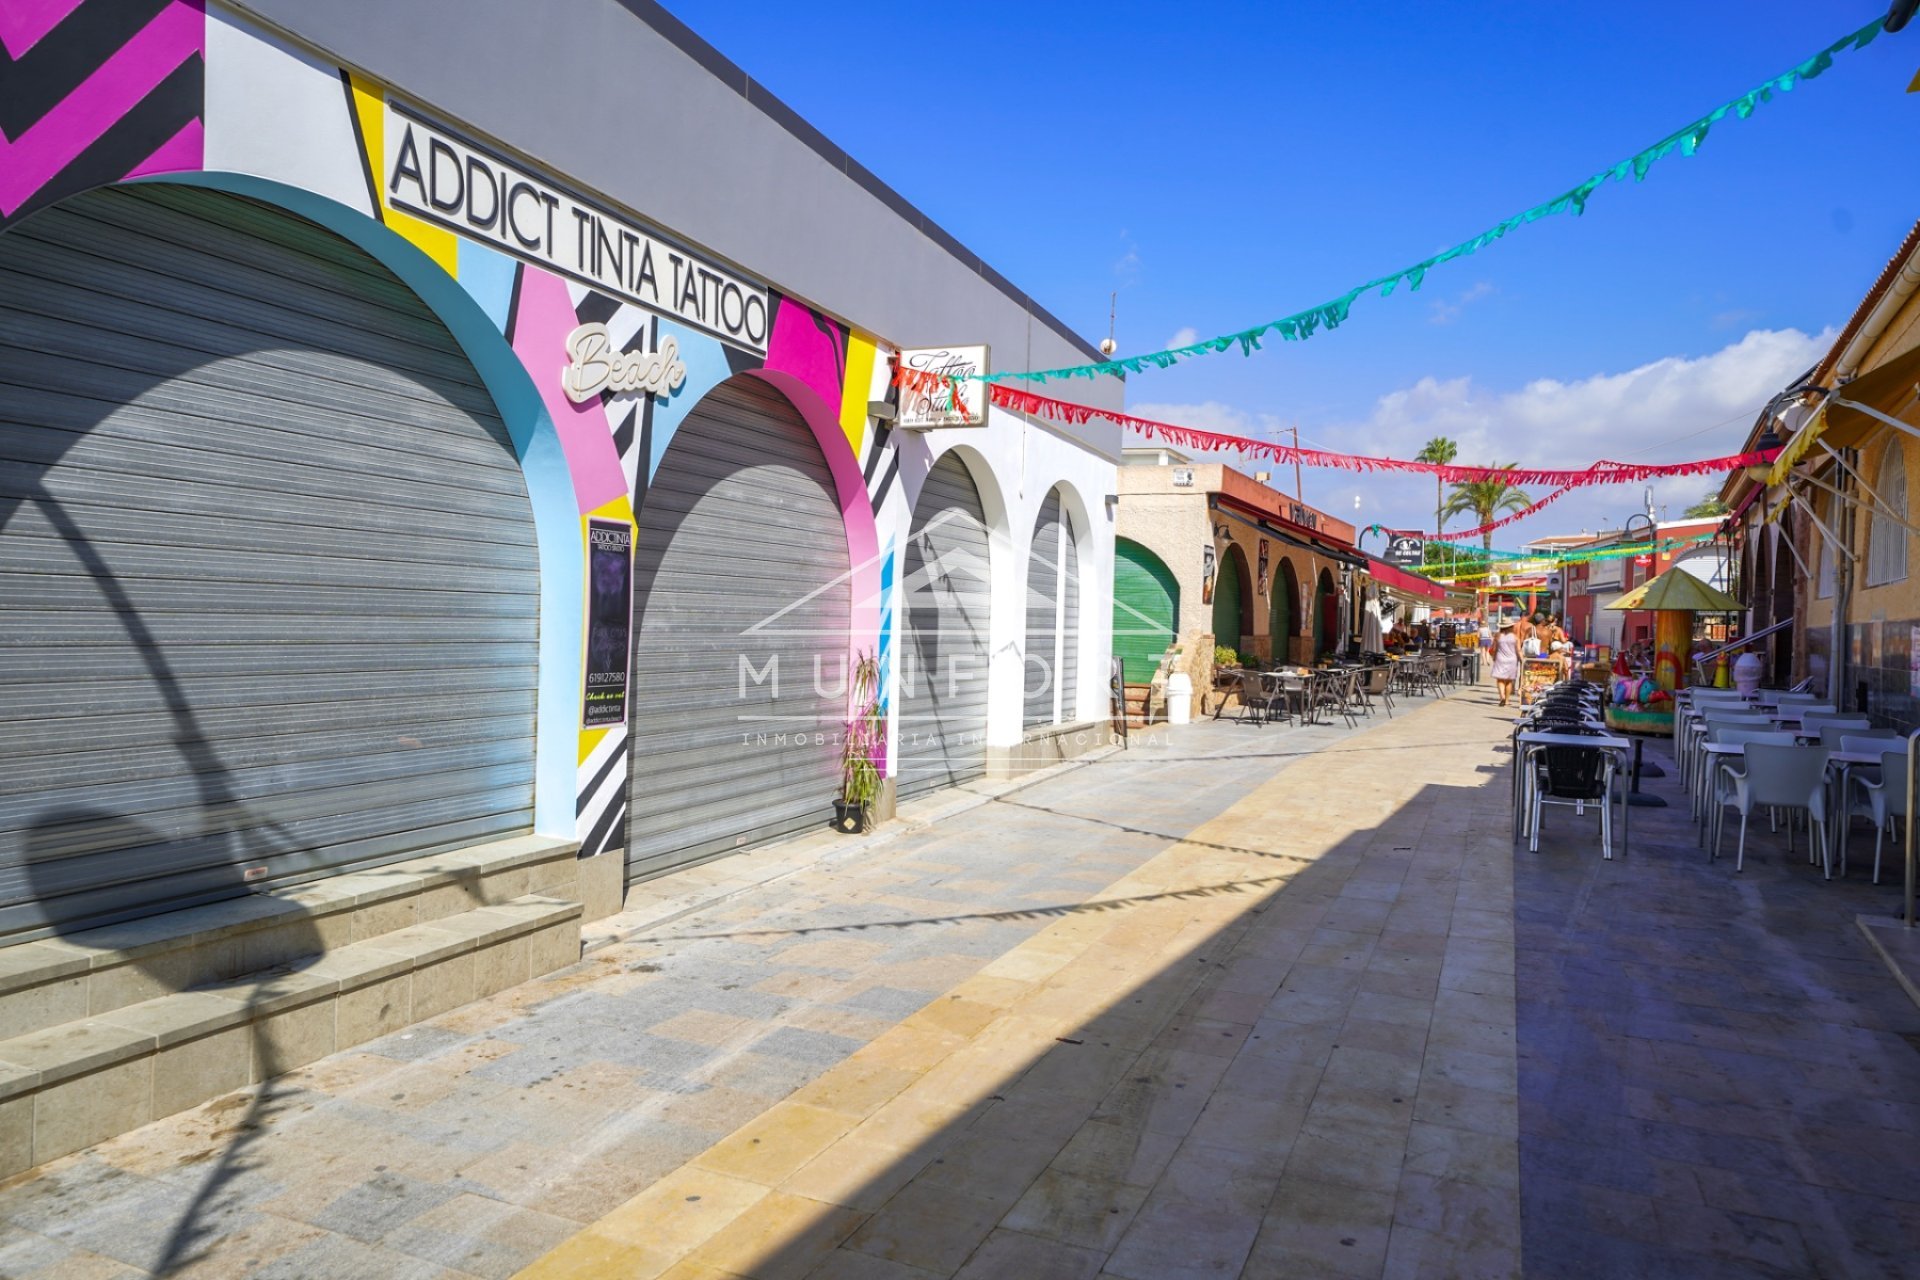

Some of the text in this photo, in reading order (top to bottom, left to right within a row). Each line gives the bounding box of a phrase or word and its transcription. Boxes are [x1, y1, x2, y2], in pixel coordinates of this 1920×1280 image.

[391, 122, 766, 345] ADDICT TINTA TATTOO
[566, 326, 686, 399] Beach
